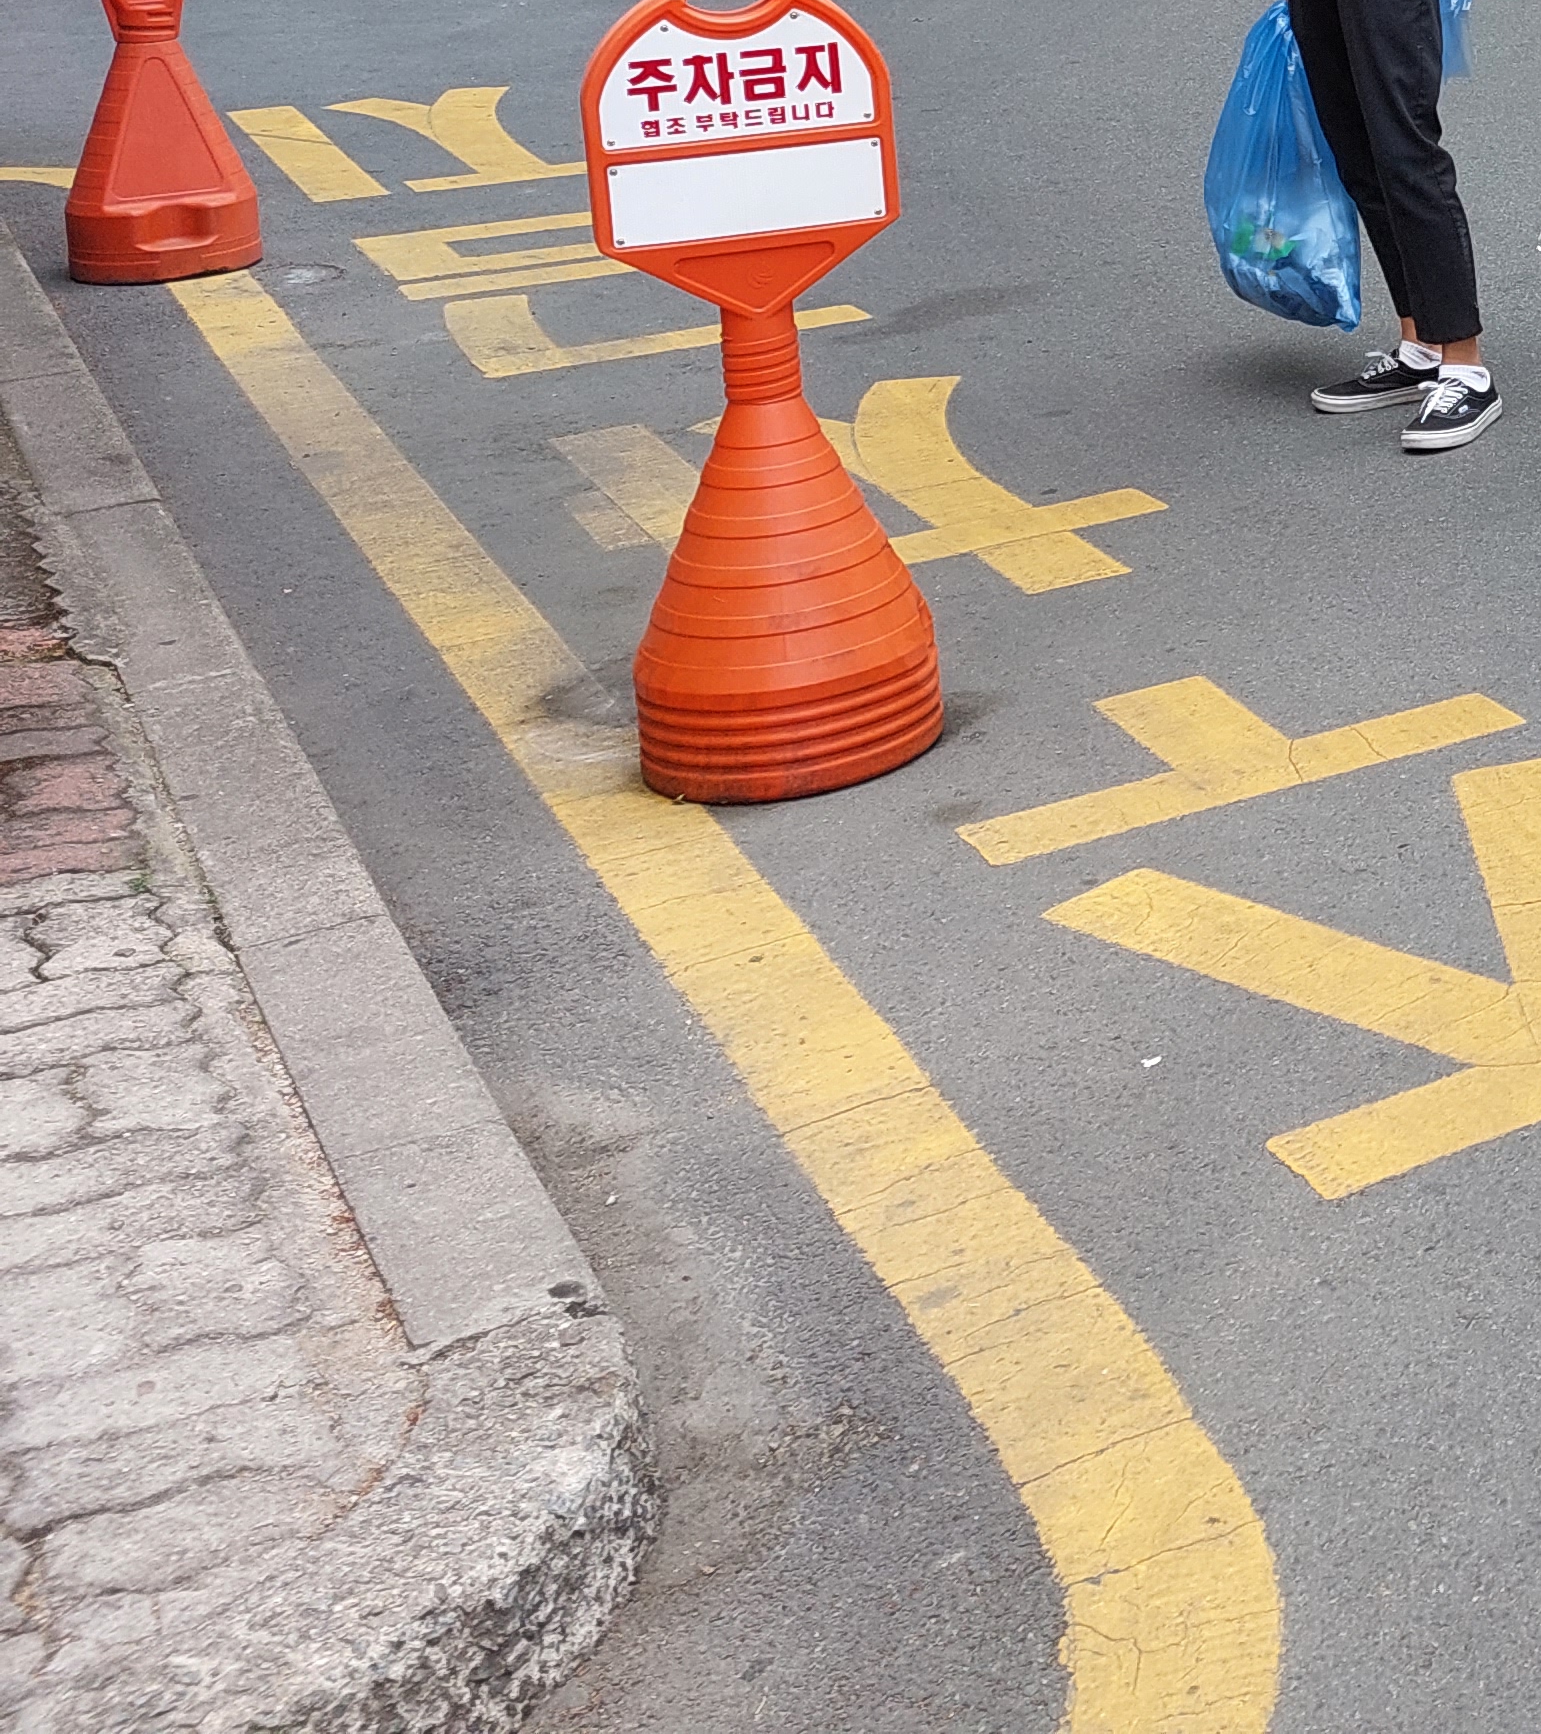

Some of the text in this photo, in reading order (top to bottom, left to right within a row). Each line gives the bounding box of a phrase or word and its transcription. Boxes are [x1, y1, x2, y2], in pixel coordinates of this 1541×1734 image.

[626, 41, 843, 113] 주차금지
[640, 101, 835, 139] 협조 부탁드립니다
